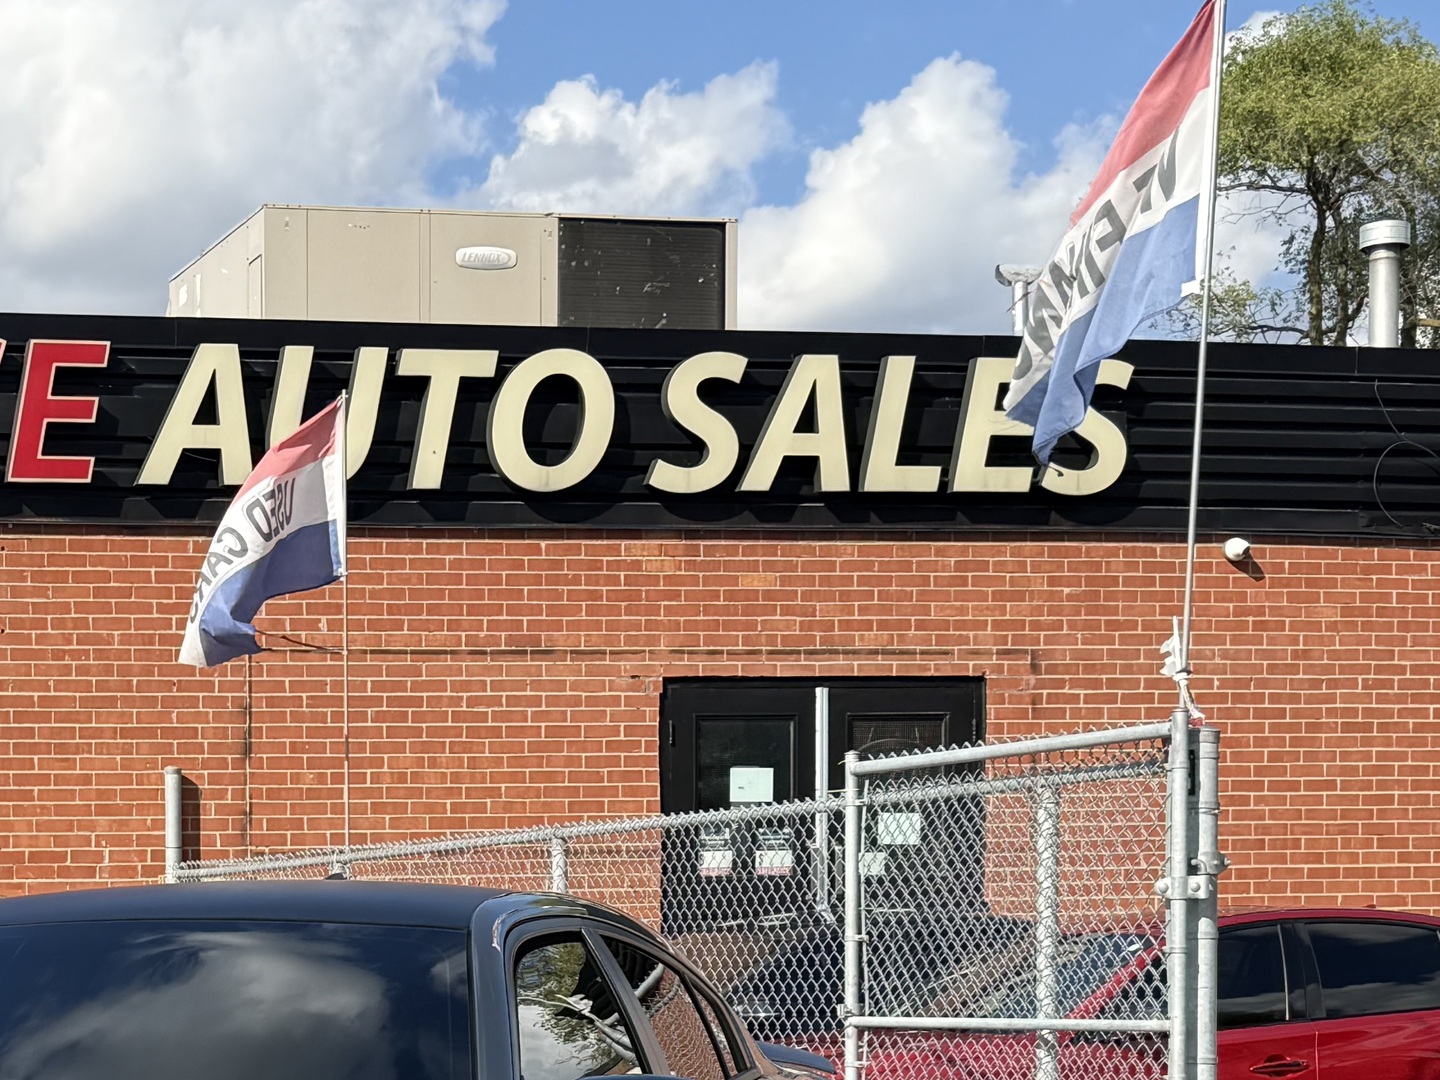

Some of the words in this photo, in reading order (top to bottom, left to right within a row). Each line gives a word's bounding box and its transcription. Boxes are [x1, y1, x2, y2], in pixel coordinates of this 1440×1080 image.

[461, 251, 503, 264] LENNOX
[136, 342, 616, 493] AUTO
[643, 351, 1135, 496] SALES
